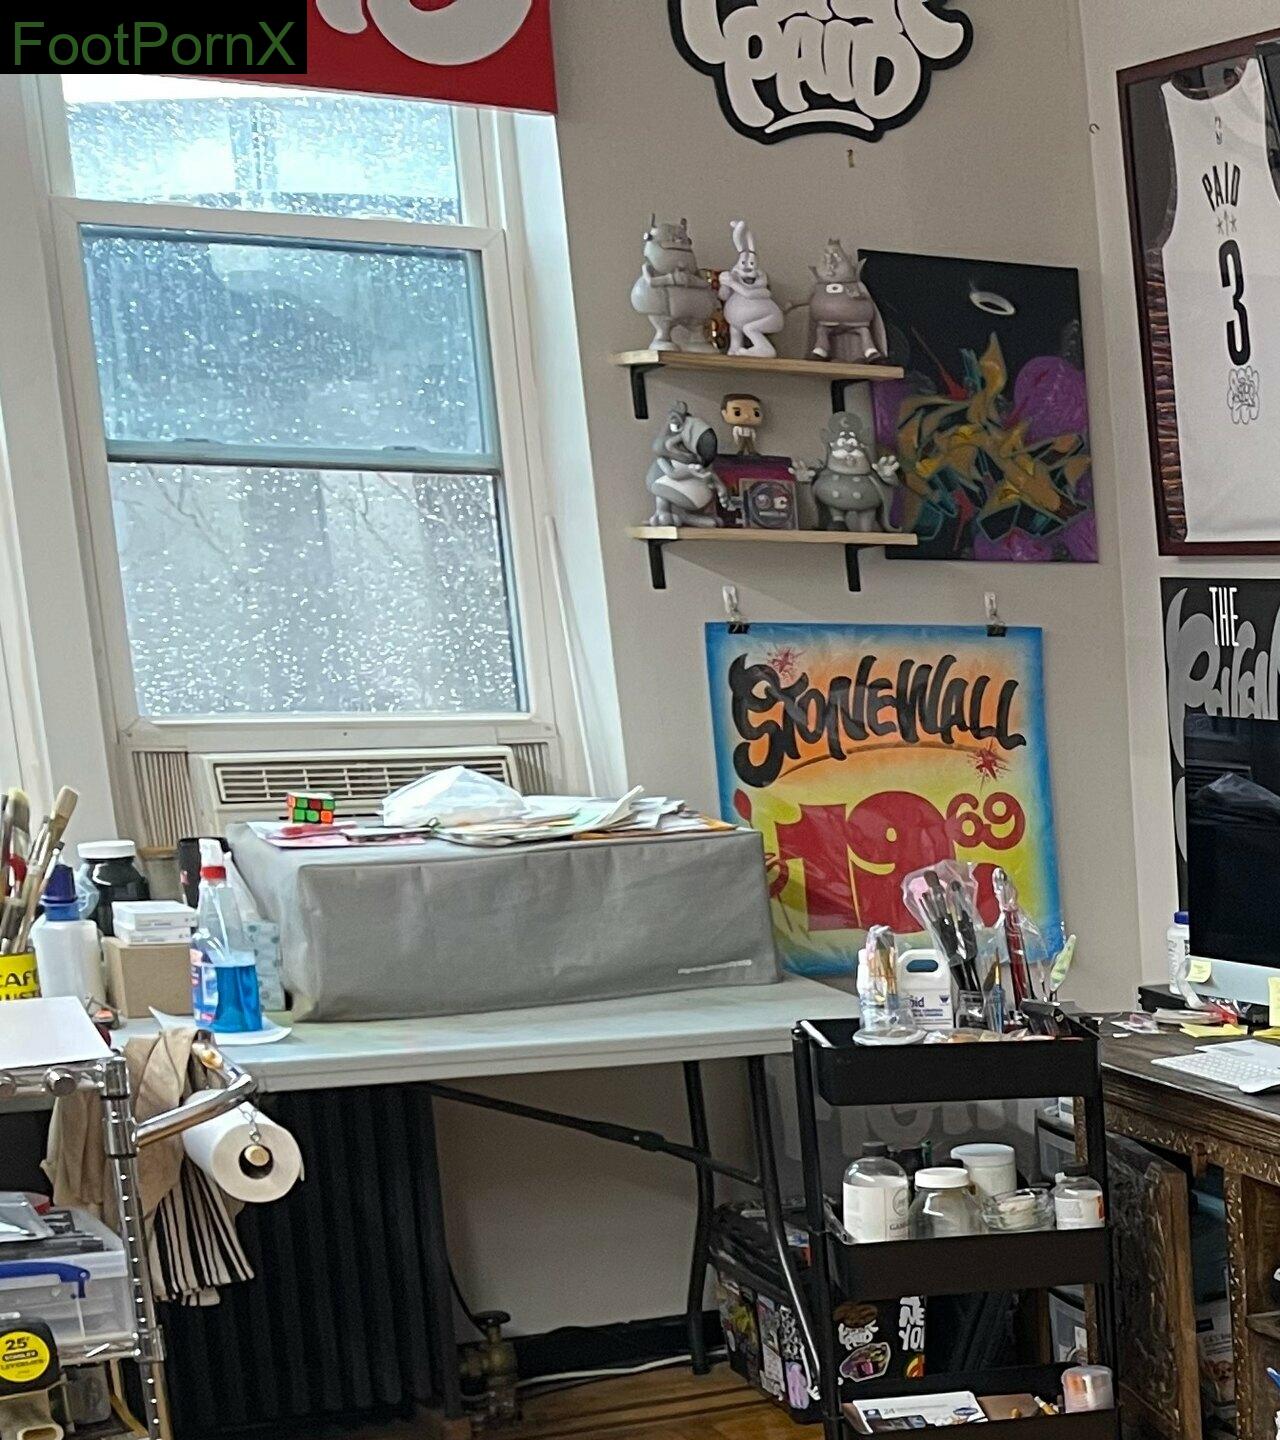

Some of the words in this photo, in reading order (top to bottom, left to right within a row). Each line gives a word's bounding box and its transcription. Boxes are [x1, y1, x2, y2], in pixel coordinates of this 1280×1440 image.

[1201, 161, 1241, 212] PAID
[1217, 239, 1251, 366] 3
[1209, 586, 1239, 647] THE
